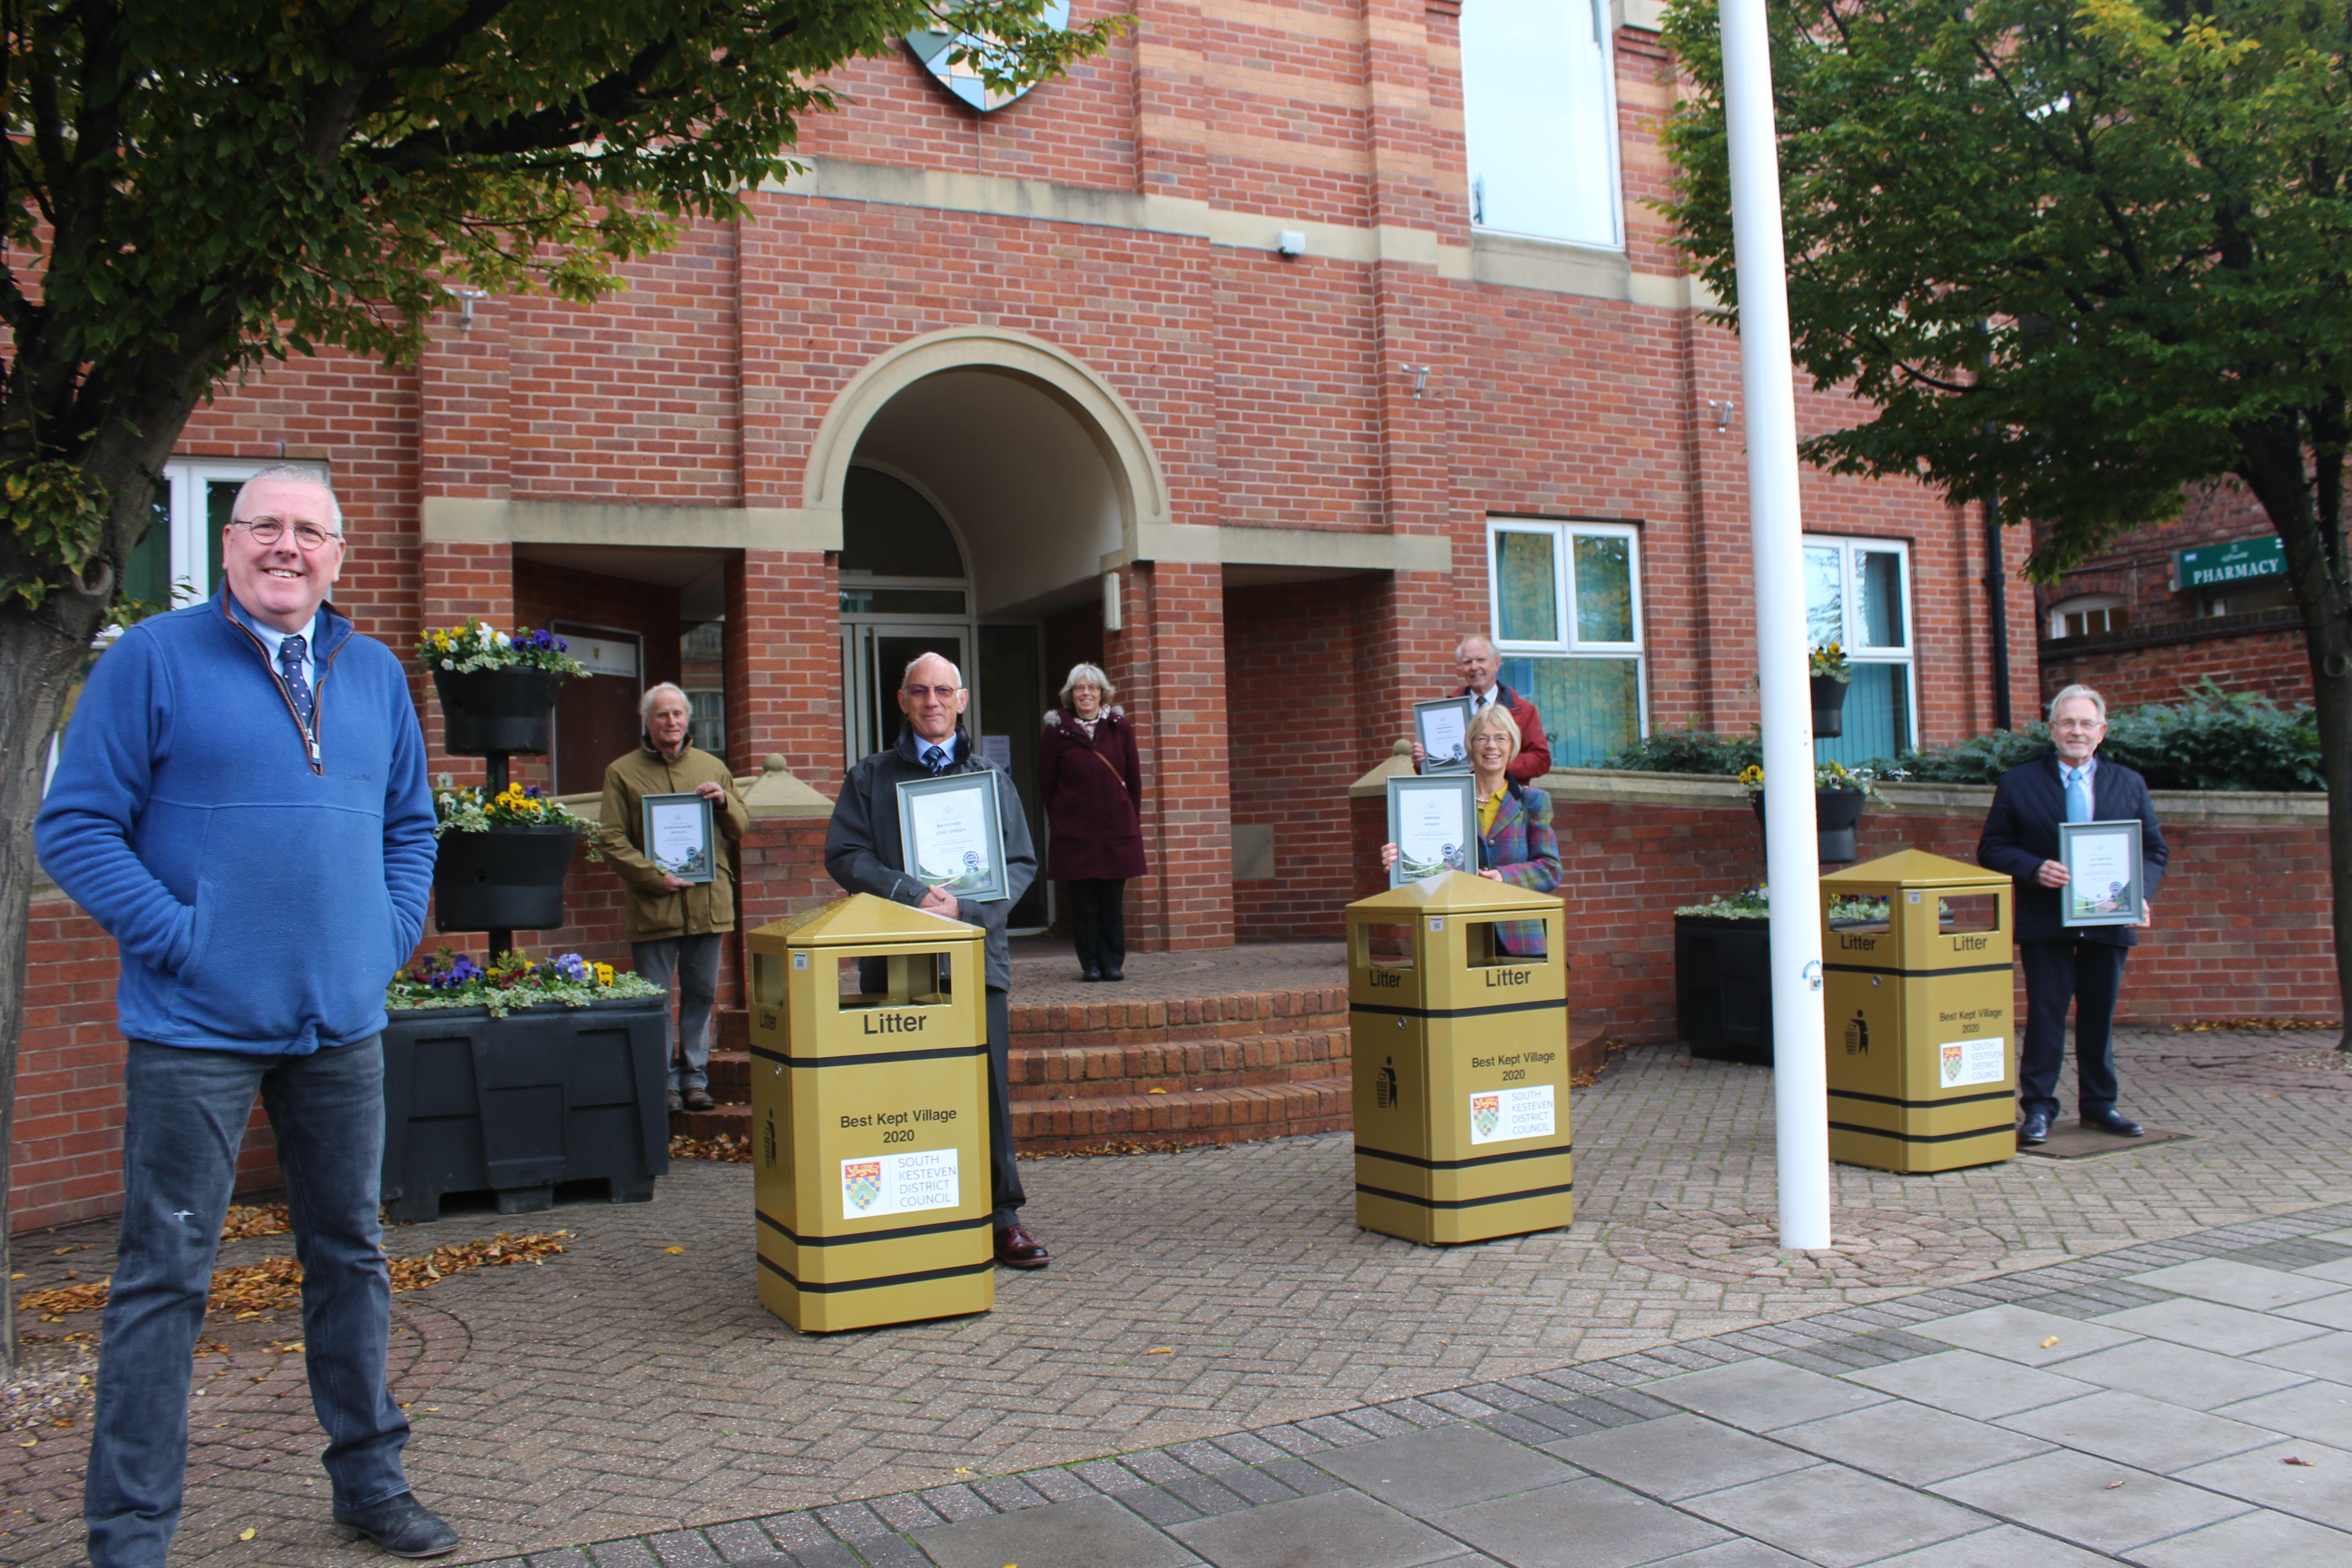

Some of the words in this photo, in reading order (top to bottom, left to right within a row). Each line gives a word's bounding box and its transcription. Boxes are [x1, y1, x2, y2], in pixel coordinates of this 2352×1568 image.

[2192, 558, 2279, 584] PHARMACY
[1841, 935, 1877, 951] Litter
[1954, 936, 1988, 953] Litter
[1369, 969, 1401, 988] Litter
[1485, 969, 1531, 987] Litter
[760, 1008, 777, 1031] Litter
[1939, 1012, 1957, 1022] Best
[1959, 1010, 1976, 1021] Kept
[1978, 1008, 2003, 1019] Village
[863, 1014, 927, 1035] Litter
[1962, 1024, 1980, 1034] 2020
[1971, 1042, 1994, 1052] SOUTH
[1472, 1056, 1494, 1068] Best
[1498, 1054, 1520, 1066] Kept
[1524, 1052, 1555, 1063] Village
[1971, 1051, 2004, 1061] KESTEVEN
[1972, 1060, 2000, 1071] DISTRICT
[1503, 1069, 1525, 1081] 2020
[1972, 1070, 2001, 1081] COUNCIL
[1511, 1090, 1542, 1102] SOUTH
[1512, 1100, 1553, 1112] KESTEVEN
[840, 1114, 872, 1128] Best
[877, 1112, 908, 1126] Kept
[912, 1109, 957, 1123] Village
[1512, 1112, 1549, 1124] DISTRICT
[1512, 1122, 1550, 1135] COUNCIL
[883, 1129, 915, 1143] 2020
[897, 1154, 939, 1168] SOUTH
[898, 1165, 956, 1181] KESTEVEN
[899, 1180, 950, 1194] DISTRICT
[899, 1192, 952, 1208] COUNCIL
